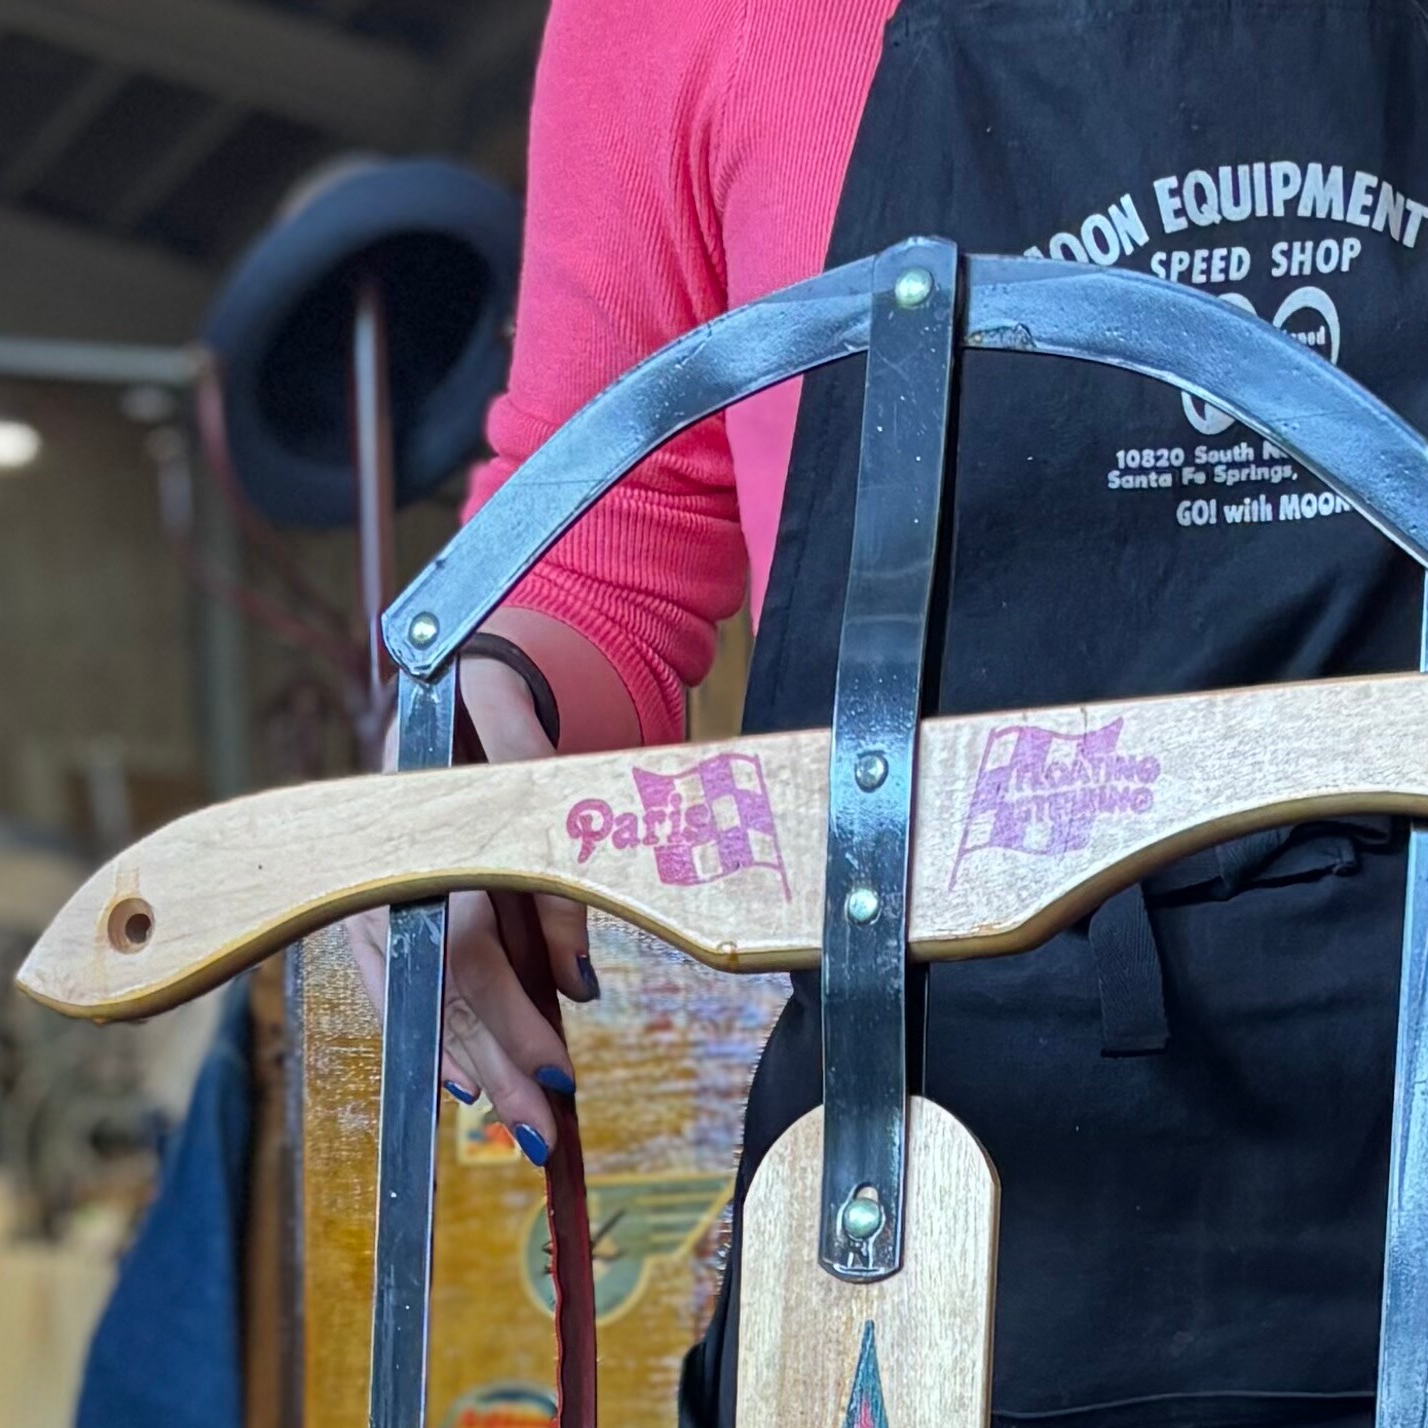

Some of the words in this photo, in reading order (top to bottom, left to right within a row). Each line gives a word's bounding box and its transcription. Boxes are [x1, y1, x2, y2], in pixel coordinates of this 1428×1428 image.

[1023, 194, 1150, 267] OON
[1150, 247, 1251, 284] SPEED
[1271, 237, 1362, 277] SHOP
[1116, 448, 1185, 469] 10820
[1195, 442, 1254, 464] South
[1108, 470, 1172, 489] Santa
[1182, 467, 1207, 486] Fe
[1214, 463, 1298, 486] Springs,
[1176, 499, 1218, 527] GO!
[1223, 494, 1273, 524] with
[566, 792, 713, 864] Paris
